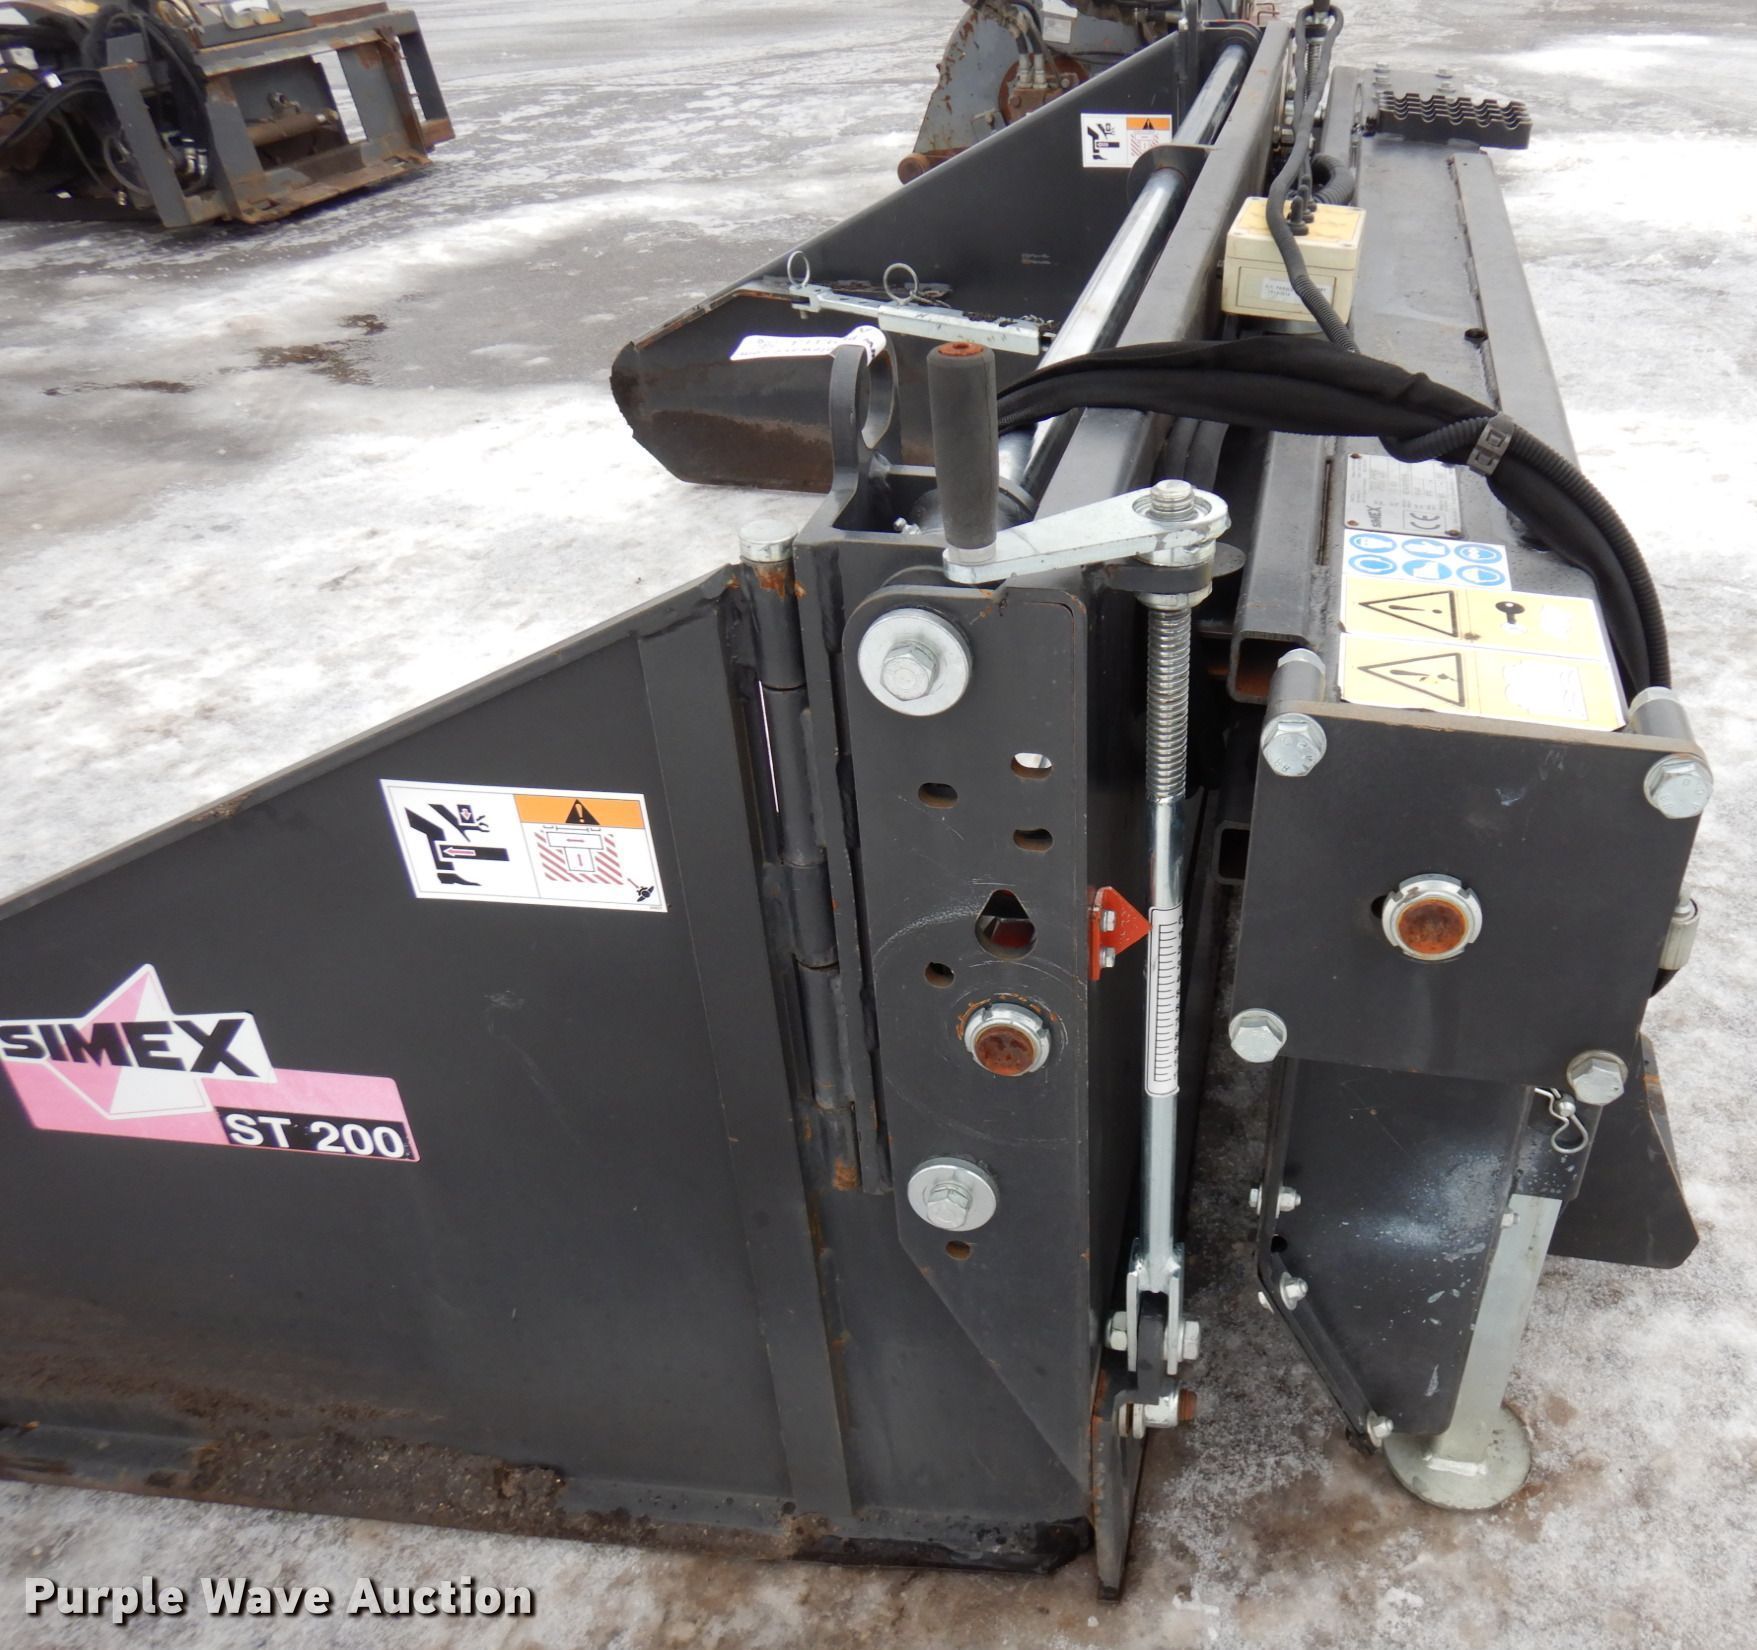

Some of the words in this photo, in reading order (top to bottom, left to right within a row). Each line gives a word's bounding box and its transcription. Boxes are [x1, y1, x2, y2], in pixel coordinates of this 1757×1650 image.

[0, 1018, 260, 1078] SIMEX
[225, 1113, 292, 1148] ST
[308, 1121, 405, 1158] 200
